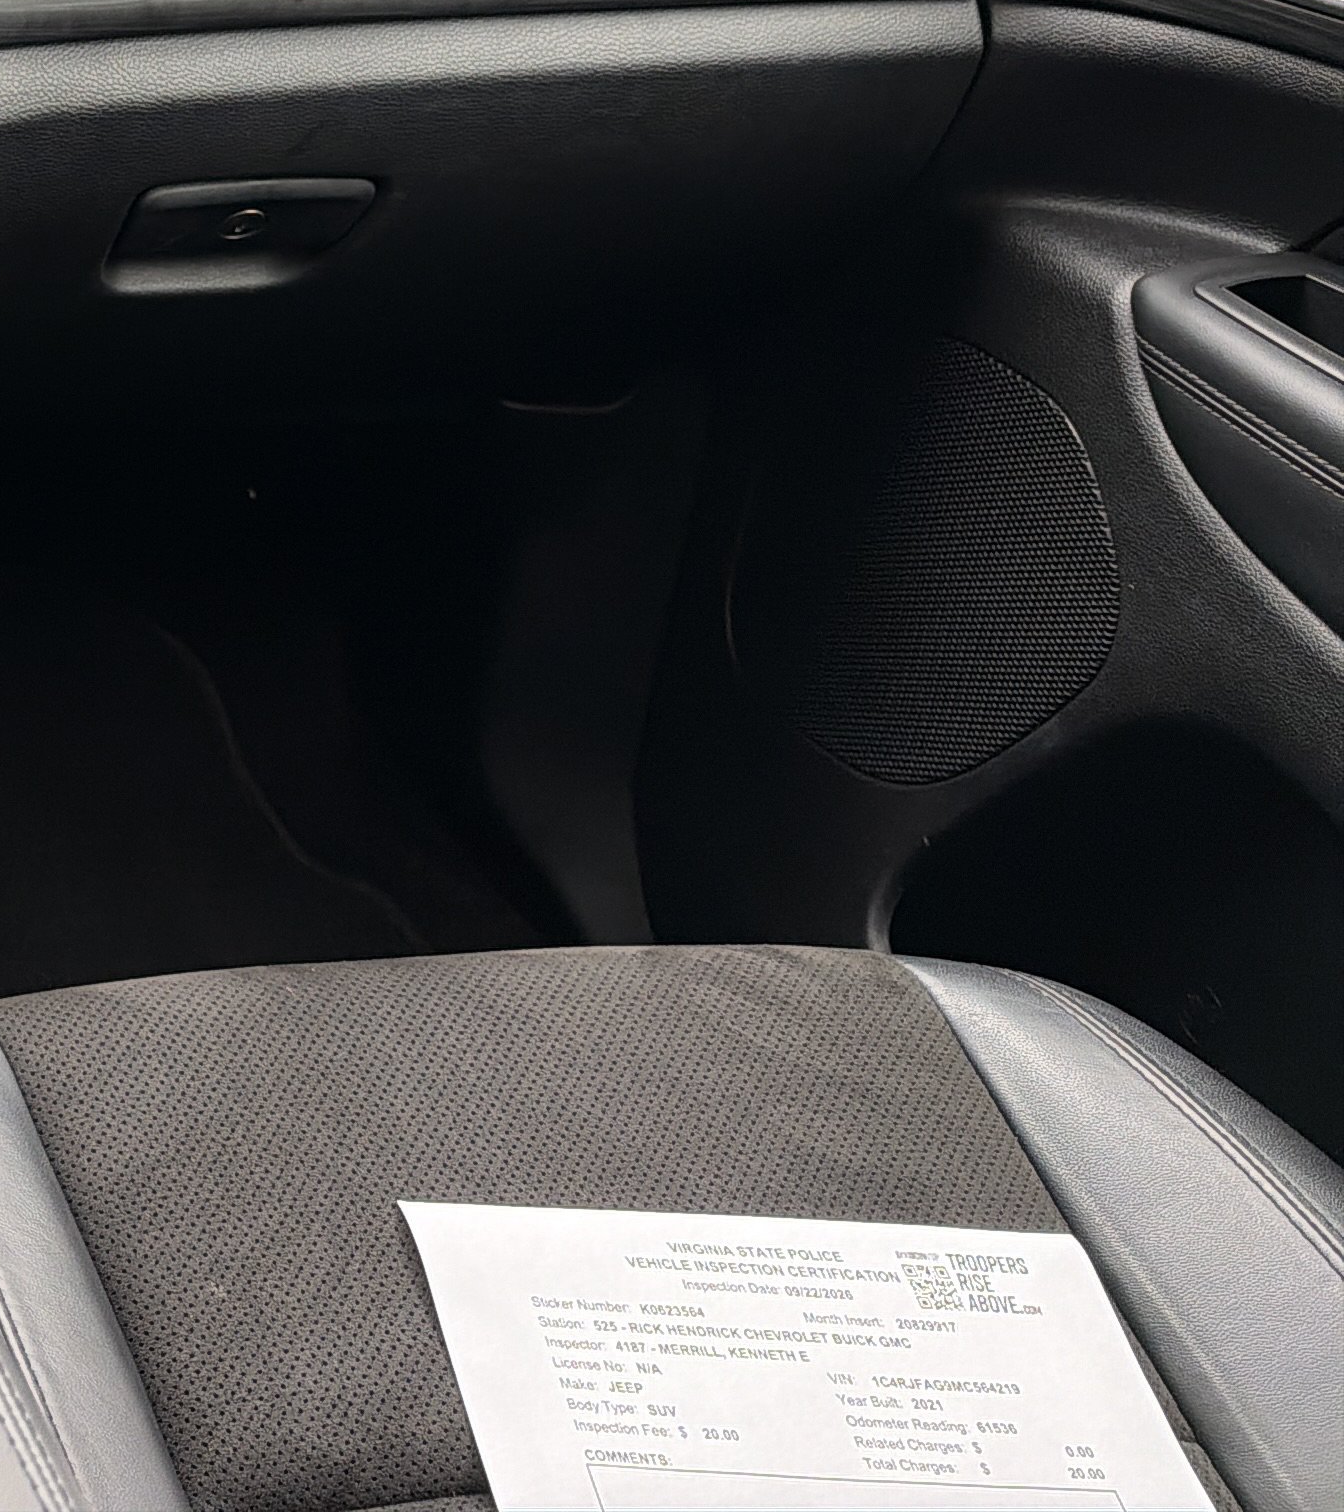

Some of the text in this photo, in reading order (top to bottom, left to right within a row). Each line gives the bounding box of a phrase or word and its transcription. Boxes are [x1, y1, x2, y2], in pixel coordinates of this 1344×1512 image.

[666, 1242, 844, 1262] VIRGINIA STATE POLICE
[625, 1256, 901, 1284] VEHICLE INSPECTION CERTIFICATION
[945, 1253, 1029, 1275] TROOPERS
[681, 1278, 746, 1294] Inspection
[956, 1273, 995, 1292] RISE
[531, 1295, 573, 1310] Sticker
[803, 1312, 842, 1326] Month
[593, 1320, 618, 1332] 525
[628, 1322, 665, 1336] RICK
[666, 1325, 742, 1339] HENDRICK
[743, 1328, 828, 1344] CHEVROLET
[831, 1333, 876, 1347] BUICK
[878, 1337, 912, 1349] GMC
[658, 1343, 727, 1360] MERRILL,
[728, 1346, 796, 1362] KENNETH
[552, 1356, 663, 1375] License N/A
[608, 1380, 644, 1393] JEEP
[566, 1398, 676, 1418] Body SUV
[836, 1393, 944, 1412] Year 2021
[574, 1419, 740, 1441] Inspection 20.00
[846, 1415, 909, 1430] Odometer
[854, 1436, 905, 1451] Related
[1064, 1445, 1095, 1459] 0.00
[584, 1448, 672, 1467] COMMENTS:
[862, 1457, 897, 1471] Total
[1067, 1466, 1106, 1480] 20.00
